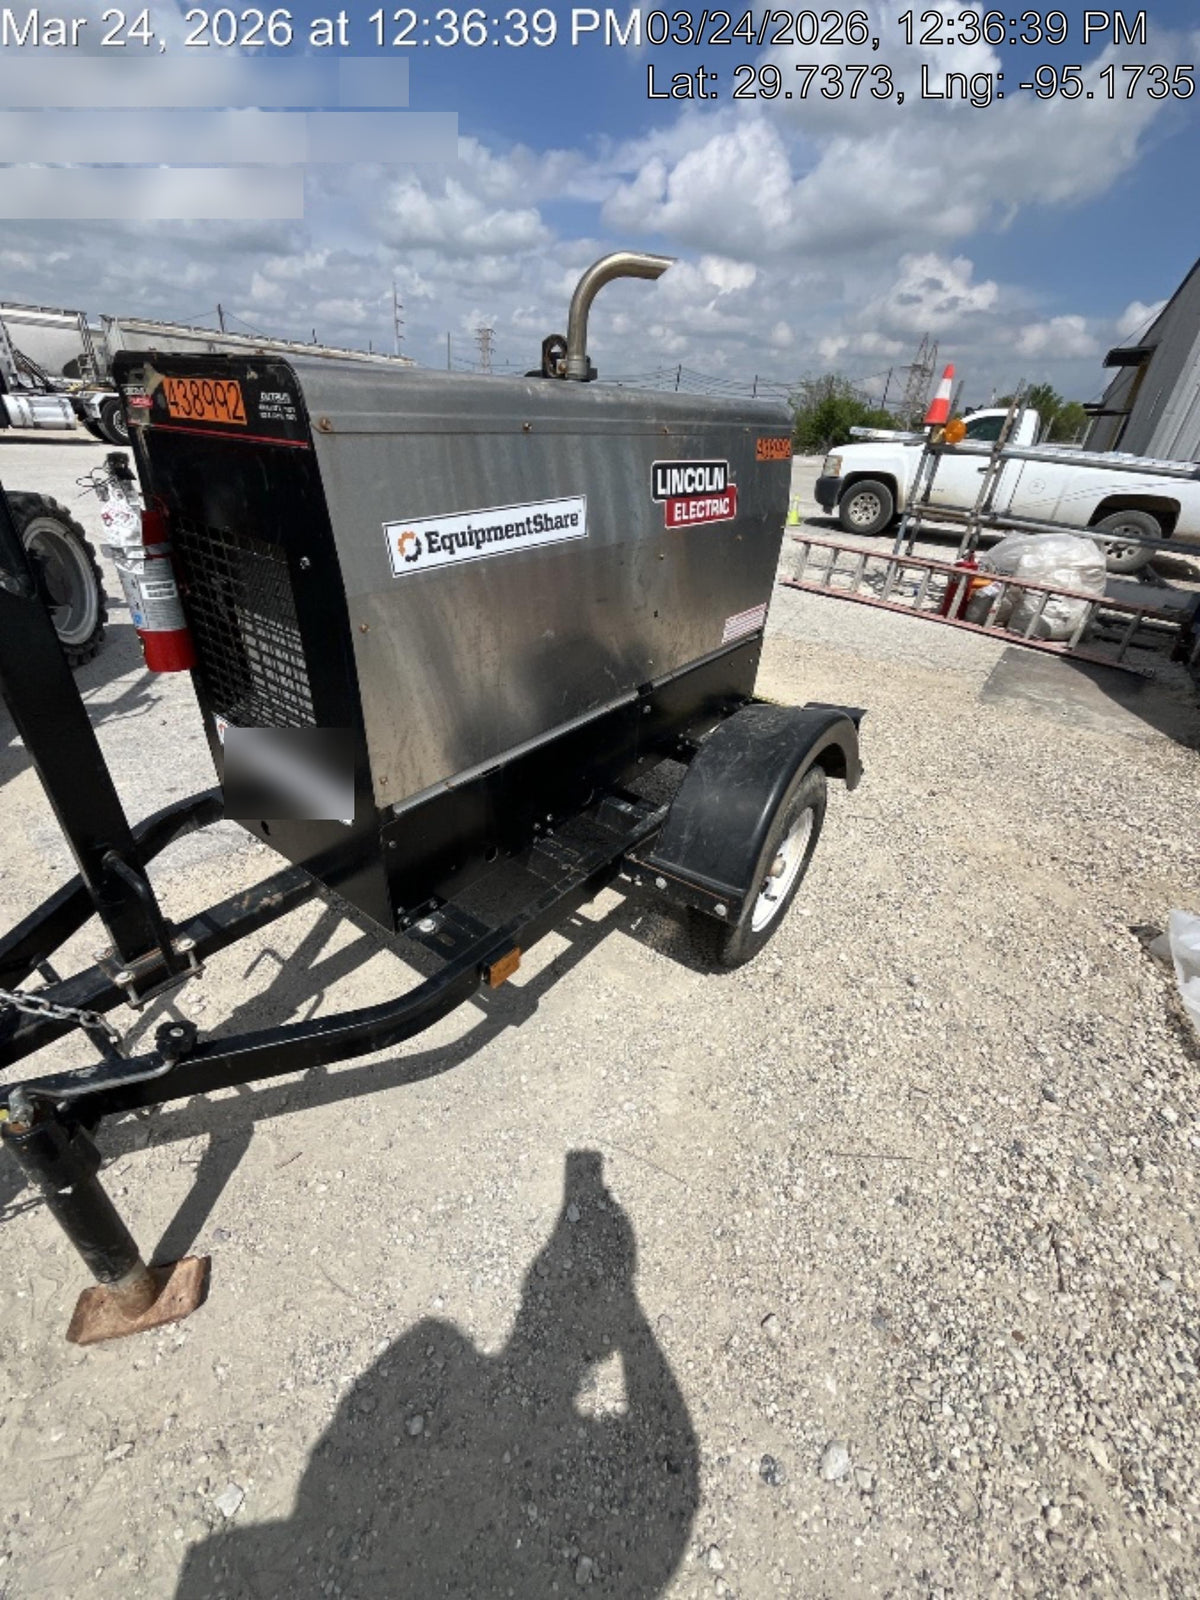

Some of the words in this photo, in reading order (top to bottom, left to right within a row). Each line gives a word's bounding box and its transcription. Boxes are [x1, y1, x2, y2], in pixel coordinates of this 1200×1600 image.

[168, 379, 244, 420] 438992
[657, 467, 724, 495] LINCOLN
[674, 498, 730, 521] ELECTRIC
[425, 512, 579, 555] EquipmentShare
